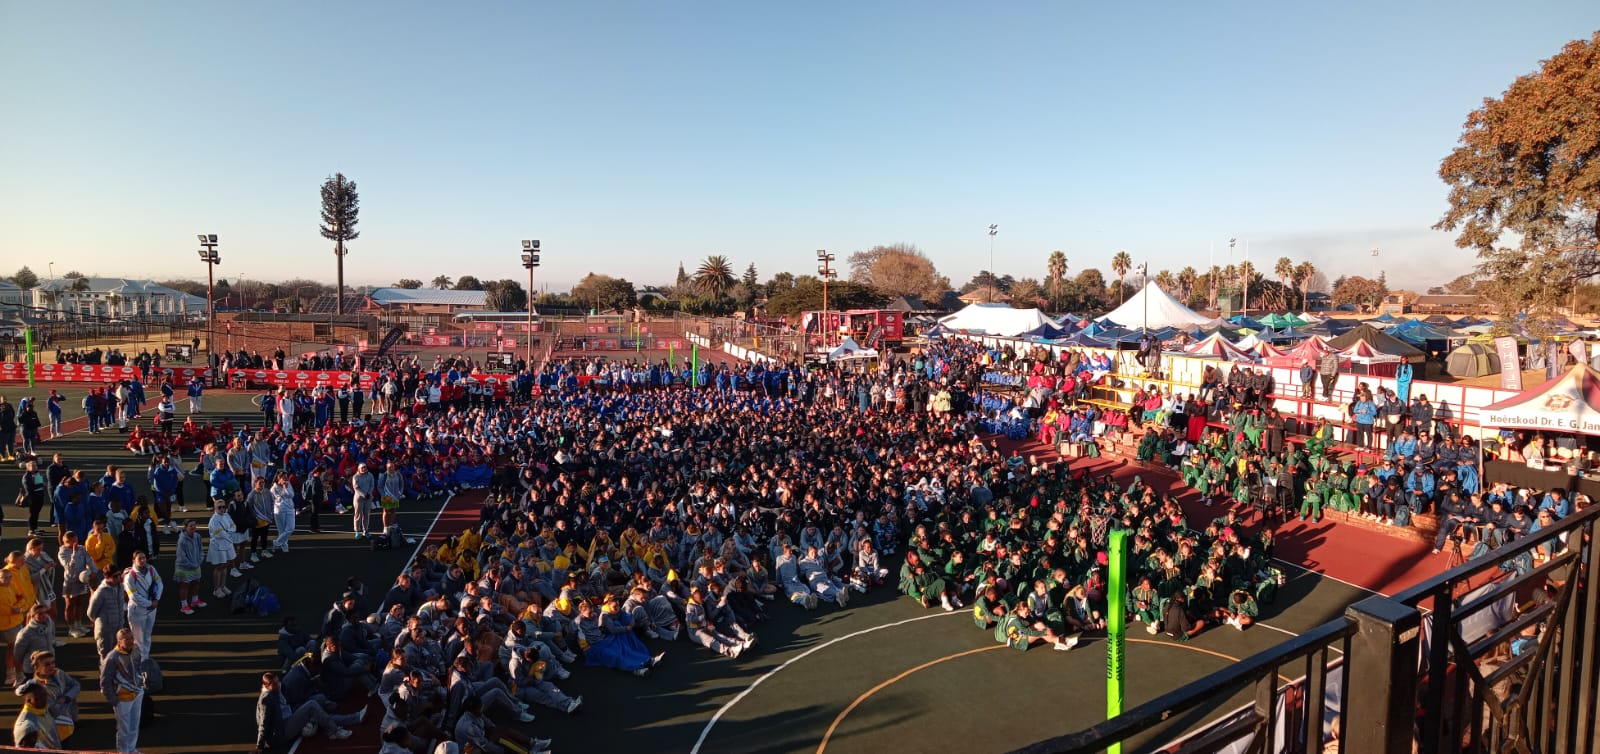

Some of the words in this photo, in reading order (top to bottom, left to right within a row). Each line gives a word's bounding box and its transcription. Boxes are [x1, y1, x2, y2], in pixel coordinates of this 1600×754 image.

[1541, 417, 1554, 426] Dr.
[1558, 418, 1566, 427] E.
[1569, 419, 1580, 429] G.
